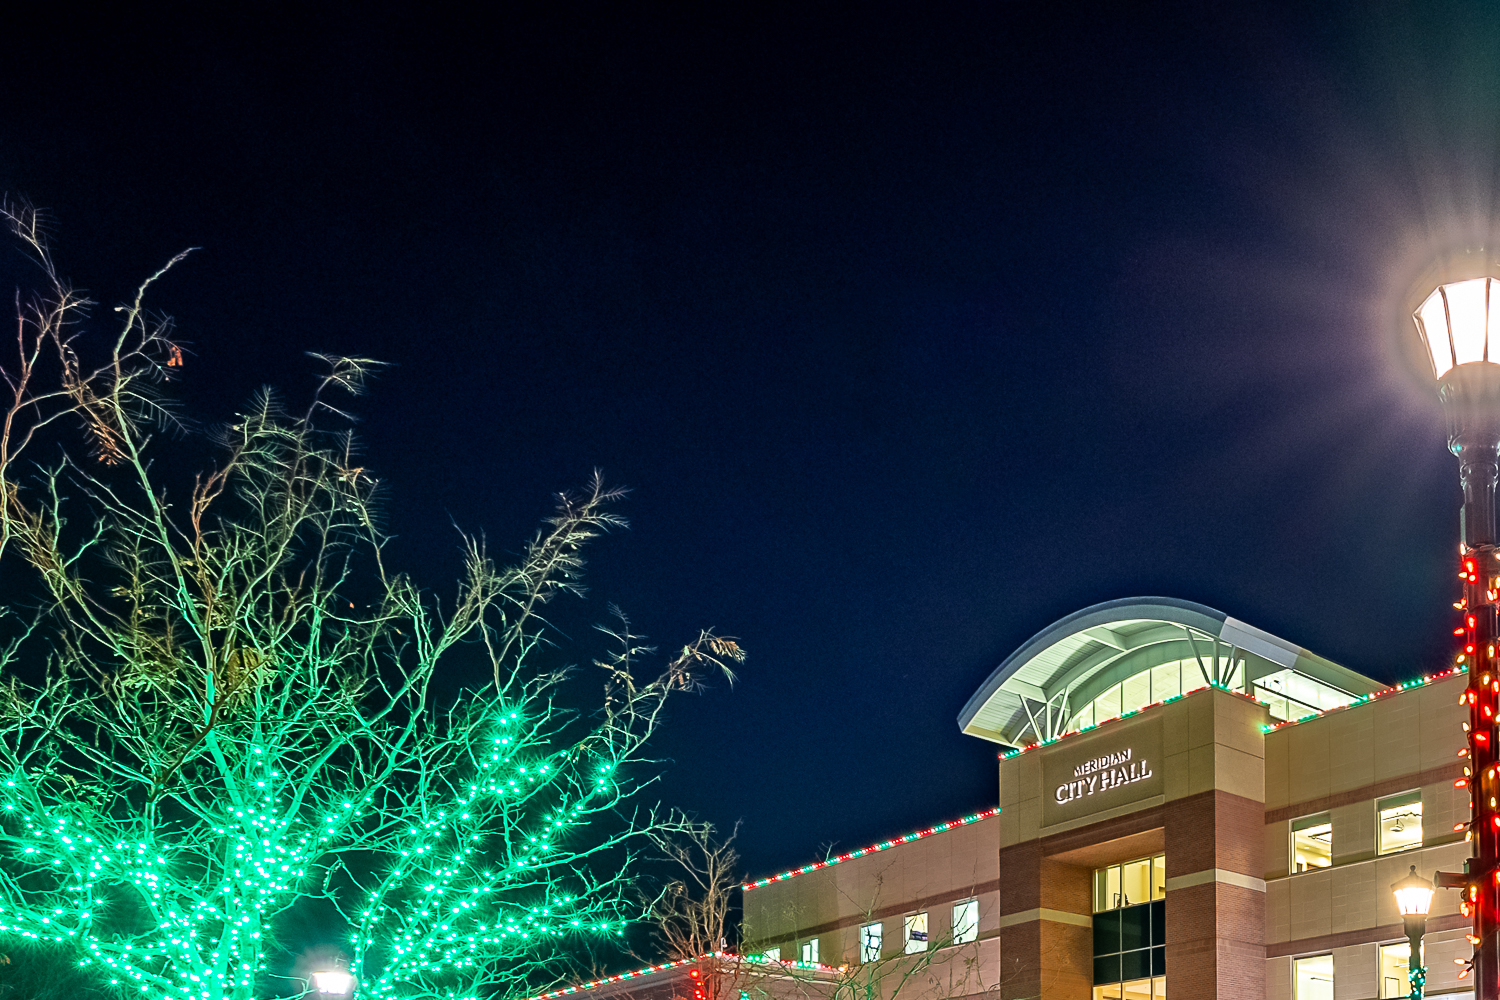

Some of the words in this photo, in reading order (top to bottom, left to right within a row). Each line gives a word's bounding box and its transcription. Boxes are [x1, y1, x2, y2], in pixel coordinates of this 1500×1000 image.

[1073, 748, 1132, 777] MERIDIAN
[1055, 775, 1098, 805] CITY
[1099, 759, 1152, 792] HALL
